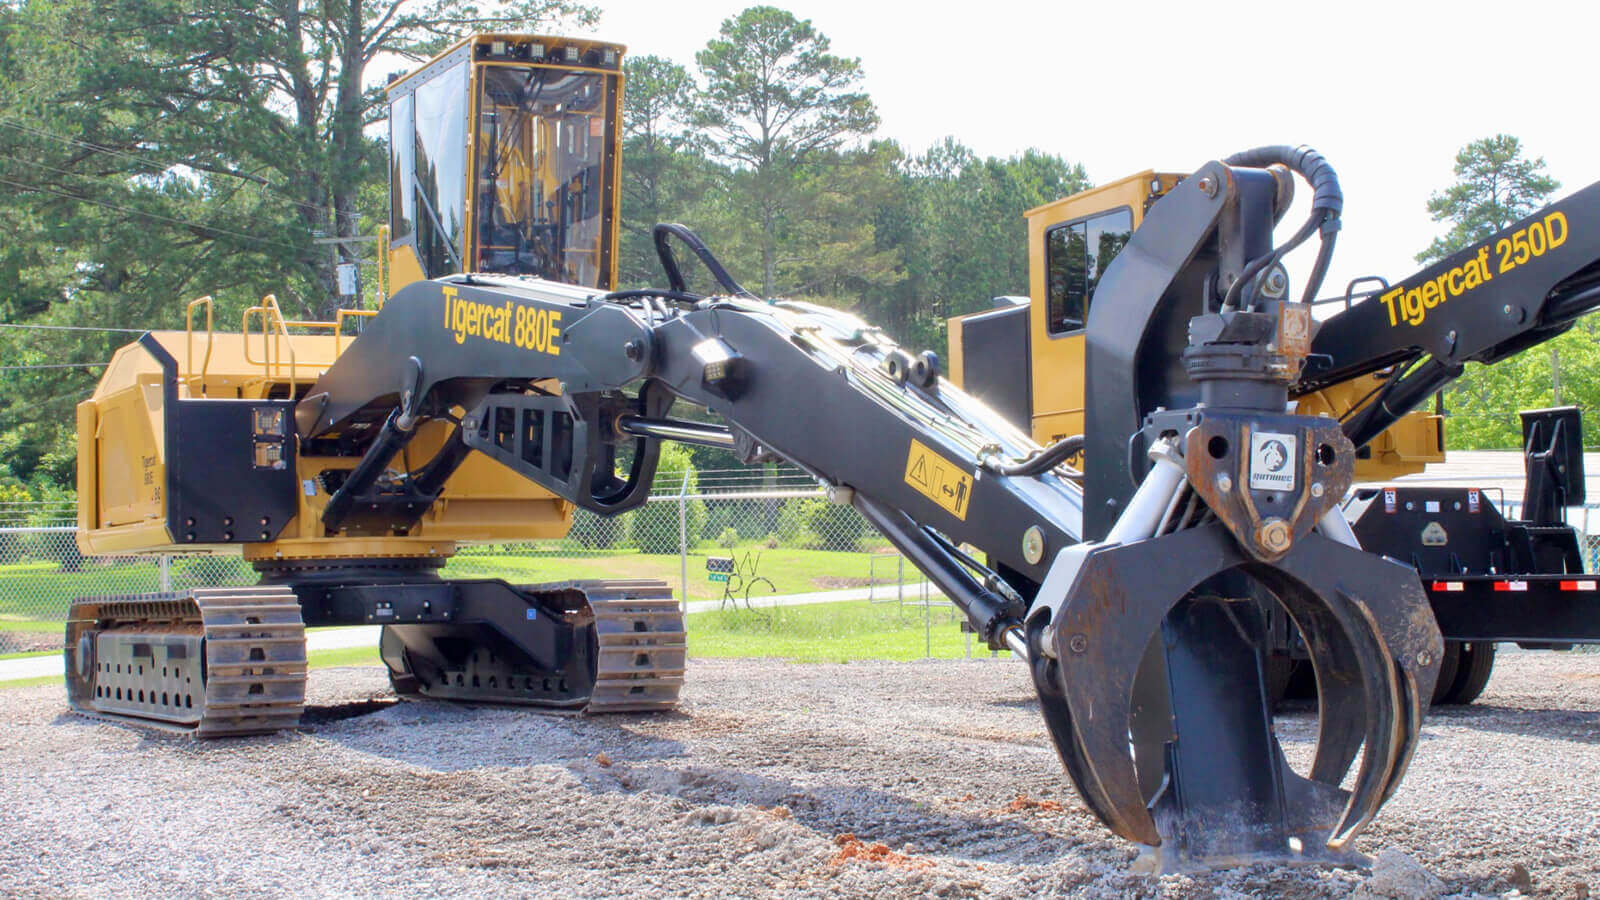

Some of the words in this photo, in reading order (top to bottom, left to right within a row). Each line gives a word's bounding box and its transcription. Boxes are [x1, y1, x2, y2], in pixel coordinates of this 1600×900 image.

[1380, 246, 1492, 327] Tigercat
[1495, 210, 1568, 275] 250D
[441, 285, 513, 345] Tigercat
[514, 304, 562, 356] 880E
